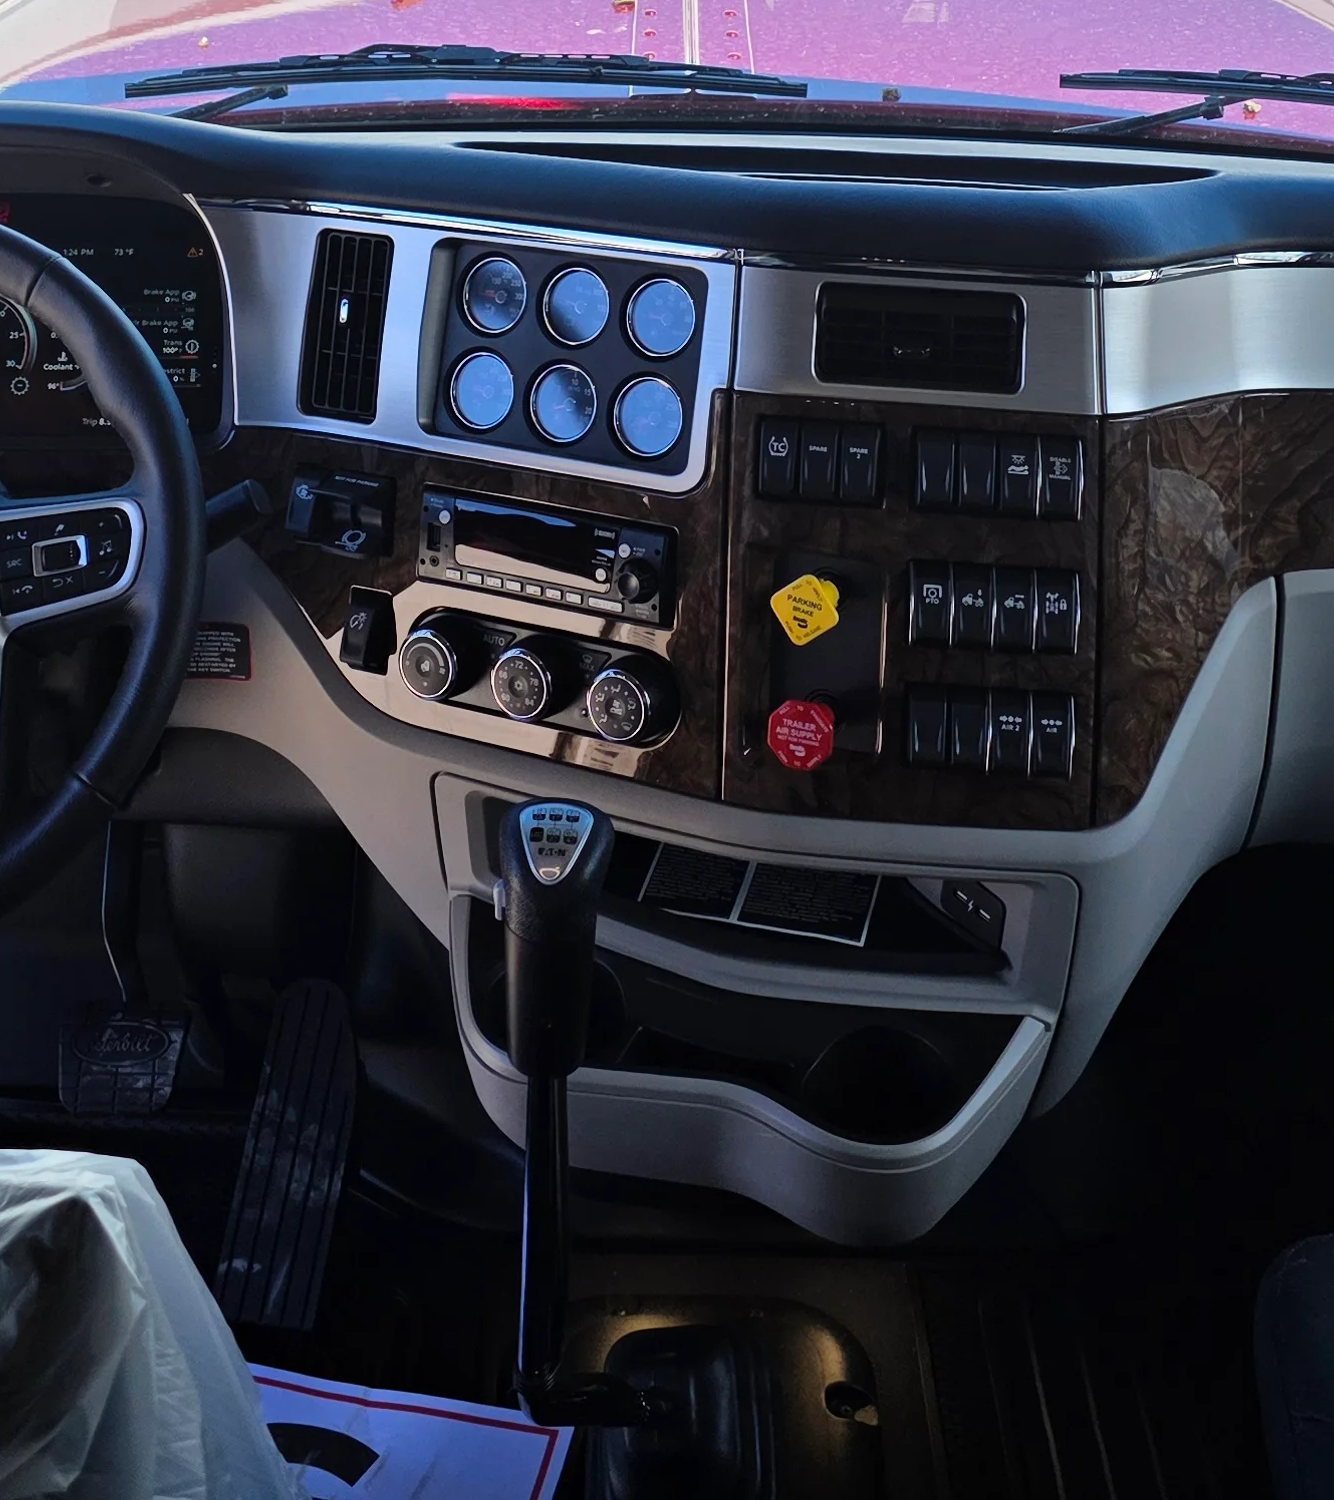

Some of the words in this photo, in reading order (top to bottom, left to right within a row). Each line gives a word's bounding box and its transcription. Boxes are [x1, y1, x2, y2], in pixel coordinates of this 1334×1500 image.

[80, 248, 95, 256] PM
[143, 288, 163, 296] Brake
[9, 331, 19, 339] 25
[43, 363, 73, 371] Coolant
[82, 417, 98, 427] Trip
[772, 441, 786, 452] TC
[6, 558, 23, 569] SRC
[787, 593, 823, 611] PARKING
[925, 597, 940, 605] PTO
[792, 605, 814, 617] BRAKE
[483, 633, 505, 646] AUTO
[782, 718, 816, 731] TRAILER
[1001, 723, 1014, 731] AIR
[775, 726, 789, 735] AIR
[790, 728, 822, 741] SUPPLY
